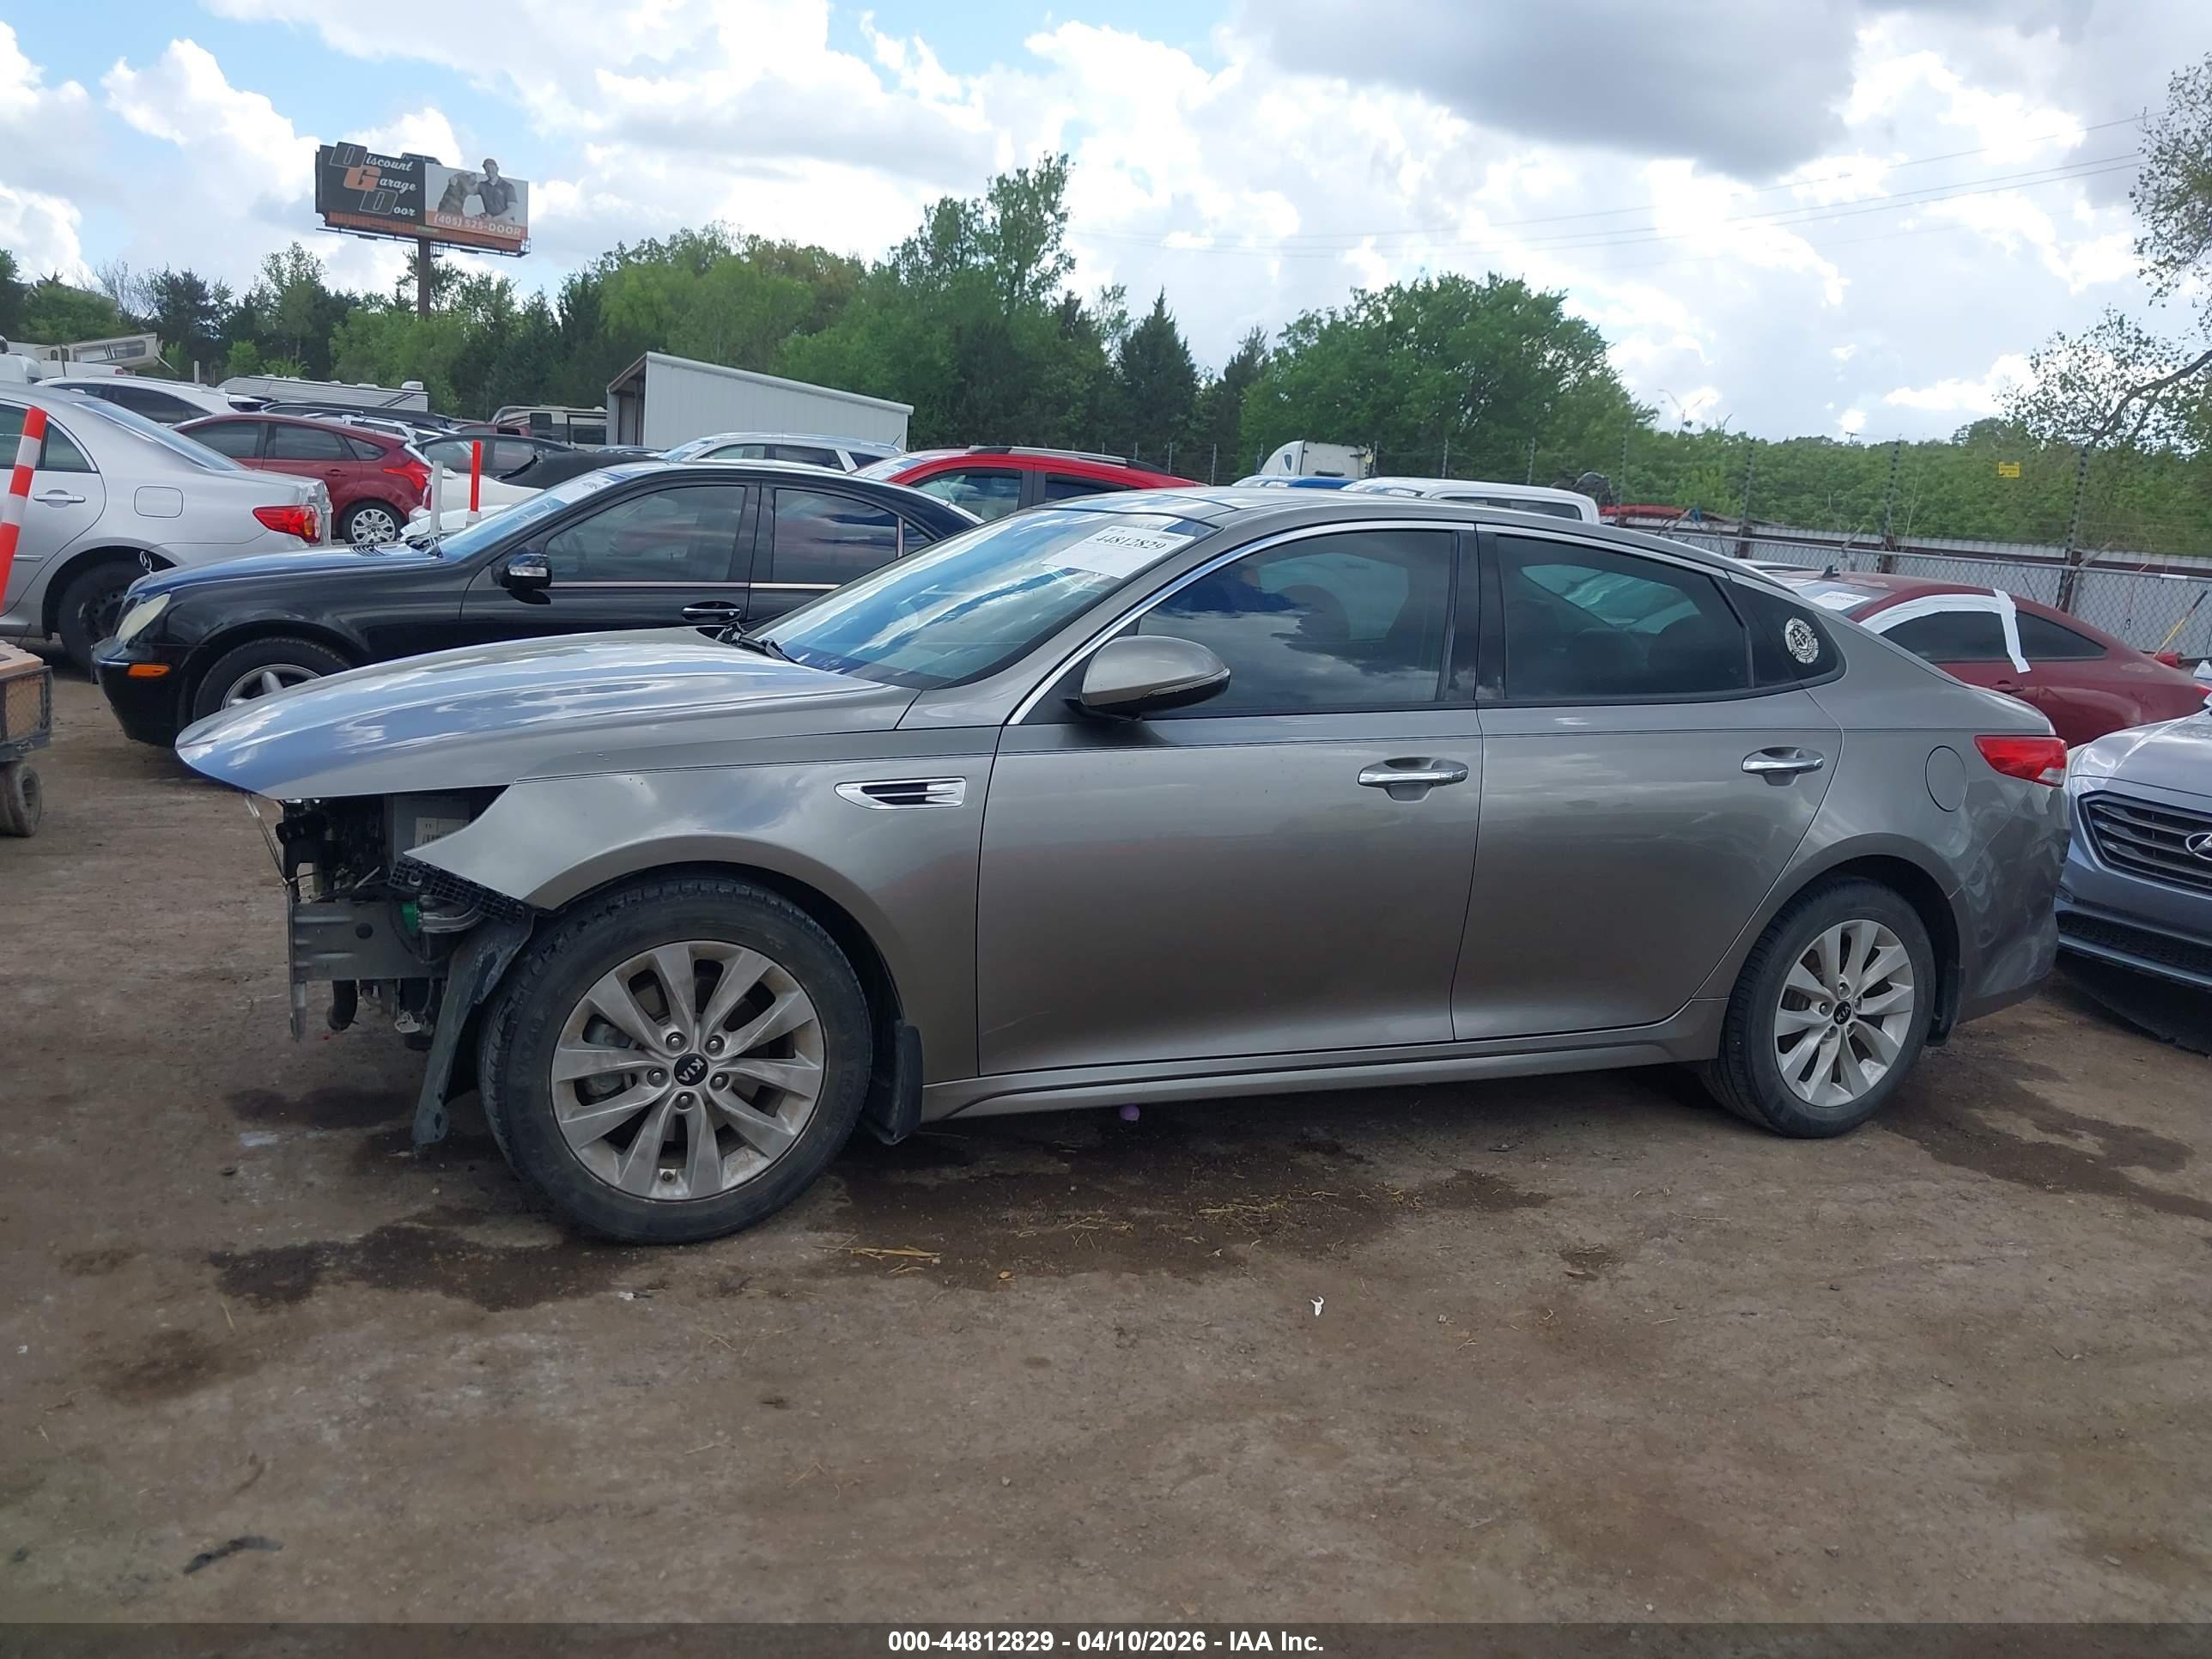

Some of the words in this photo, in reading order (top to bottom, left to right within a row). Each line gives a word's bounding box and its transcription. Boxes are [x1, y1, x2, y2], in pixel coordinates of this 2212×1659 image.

[330, 142, 413, 172] Discount
[343, 164, 417, 194] Garage
[359, 187, 416, 216] Door
[434, 214, 462, 228] (405)
[465, 220, 521, 236] 525-DOOR
[1097, 535, 1166, 550] 44812829
[1836, 1006, 1850, 1022] KIA
[678, 1058, 704, 1081] KIA
